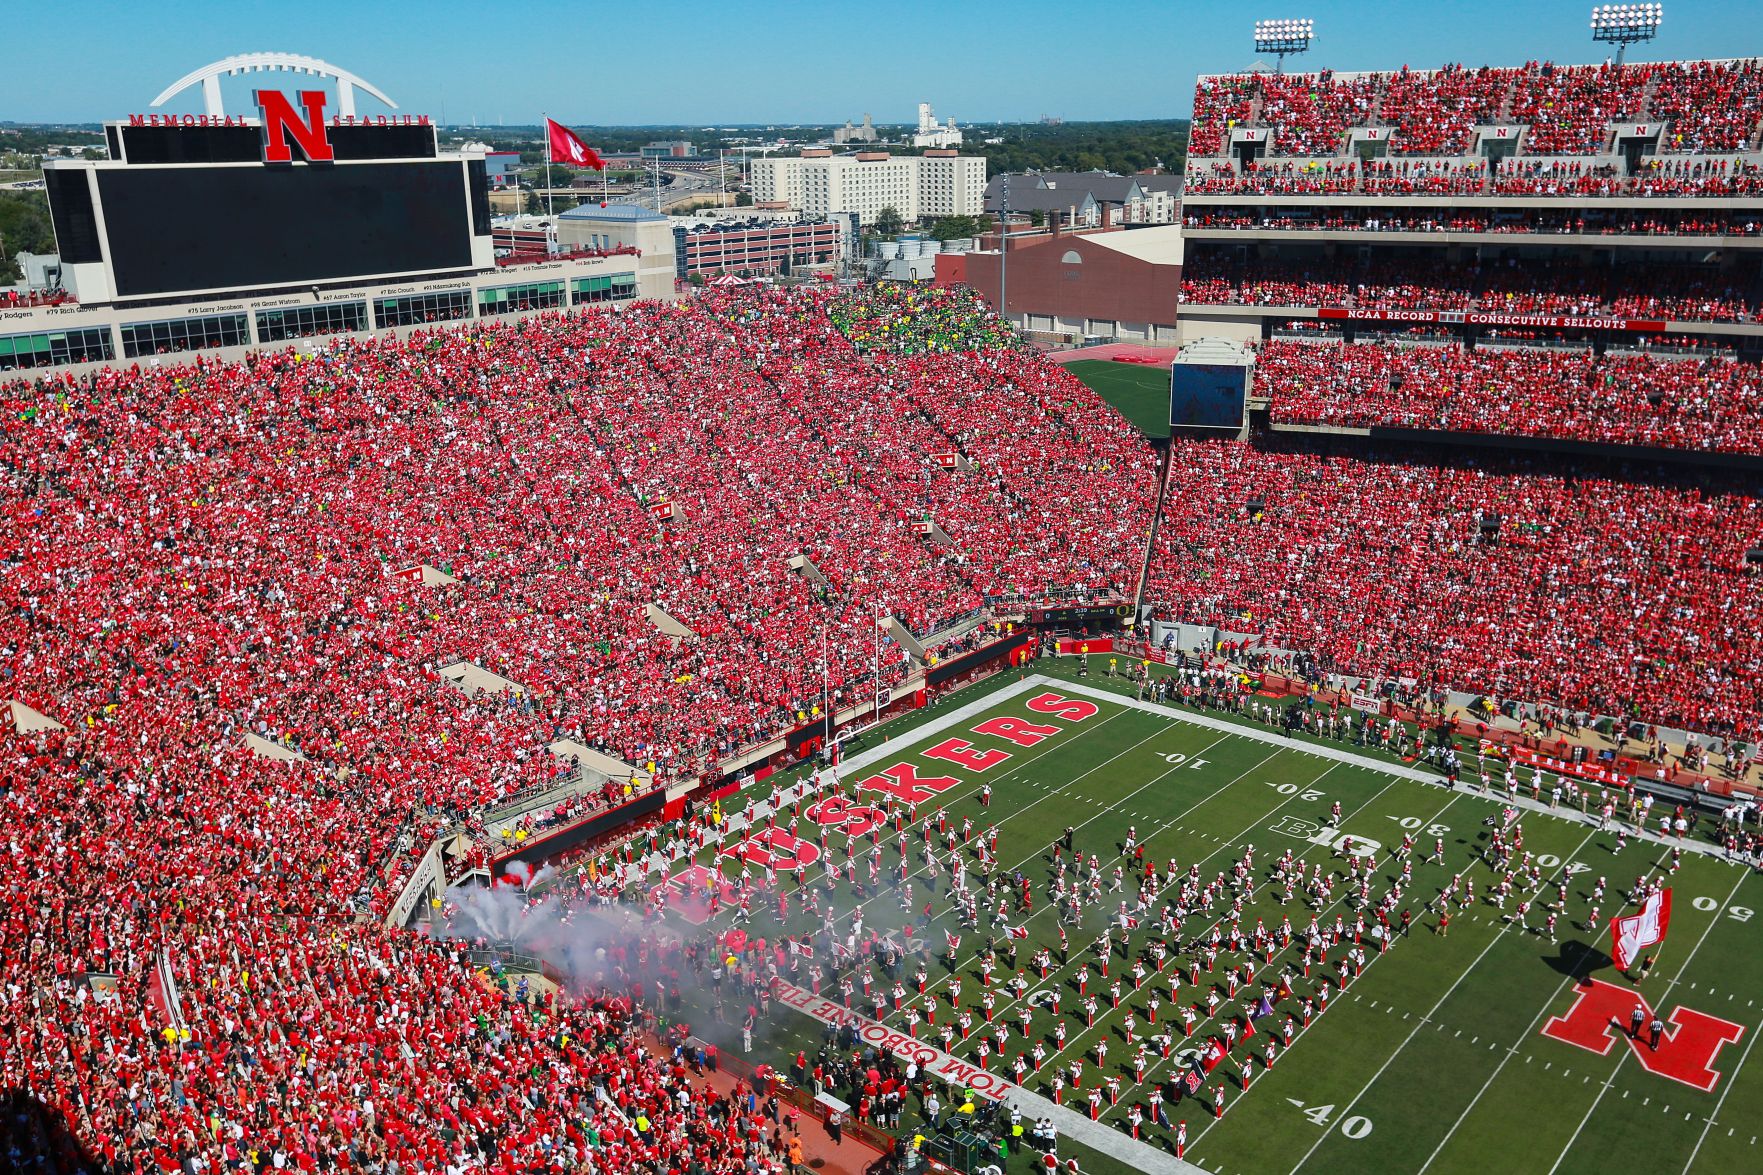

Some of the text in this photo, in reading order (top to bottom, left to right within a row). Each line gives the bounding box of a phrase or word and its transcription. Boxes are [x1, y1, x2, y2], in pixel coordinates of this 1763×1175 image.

[128, 114, 430, 127] MEMORIAL STADIUM
[256, 89, 335, 162] N
[1246, 131, 1255, 139] N
[1368, 130, 1378, 139] N
[1496, 128, 1507, 137] N
[1635, 126, 1647, 136] N
[4, 311, 33, 319] Rodgers
[1347, 310, 1381, 319] NCAA
[1386, 311, 1434, 321] RECORD
[1470, 314, 1558, 326] CONSECUTIVE
[1563, 317, 1627, 329] SELLOUTS
[1354, 697, 1379, 709] ESPN
[650, 691, 1100, 926] HUSKERS
[1540, 977, 1746, 1093] N
[938, 1059, 1012, 1100] TOM
[1303, 1103, 1373, 1139] 40
